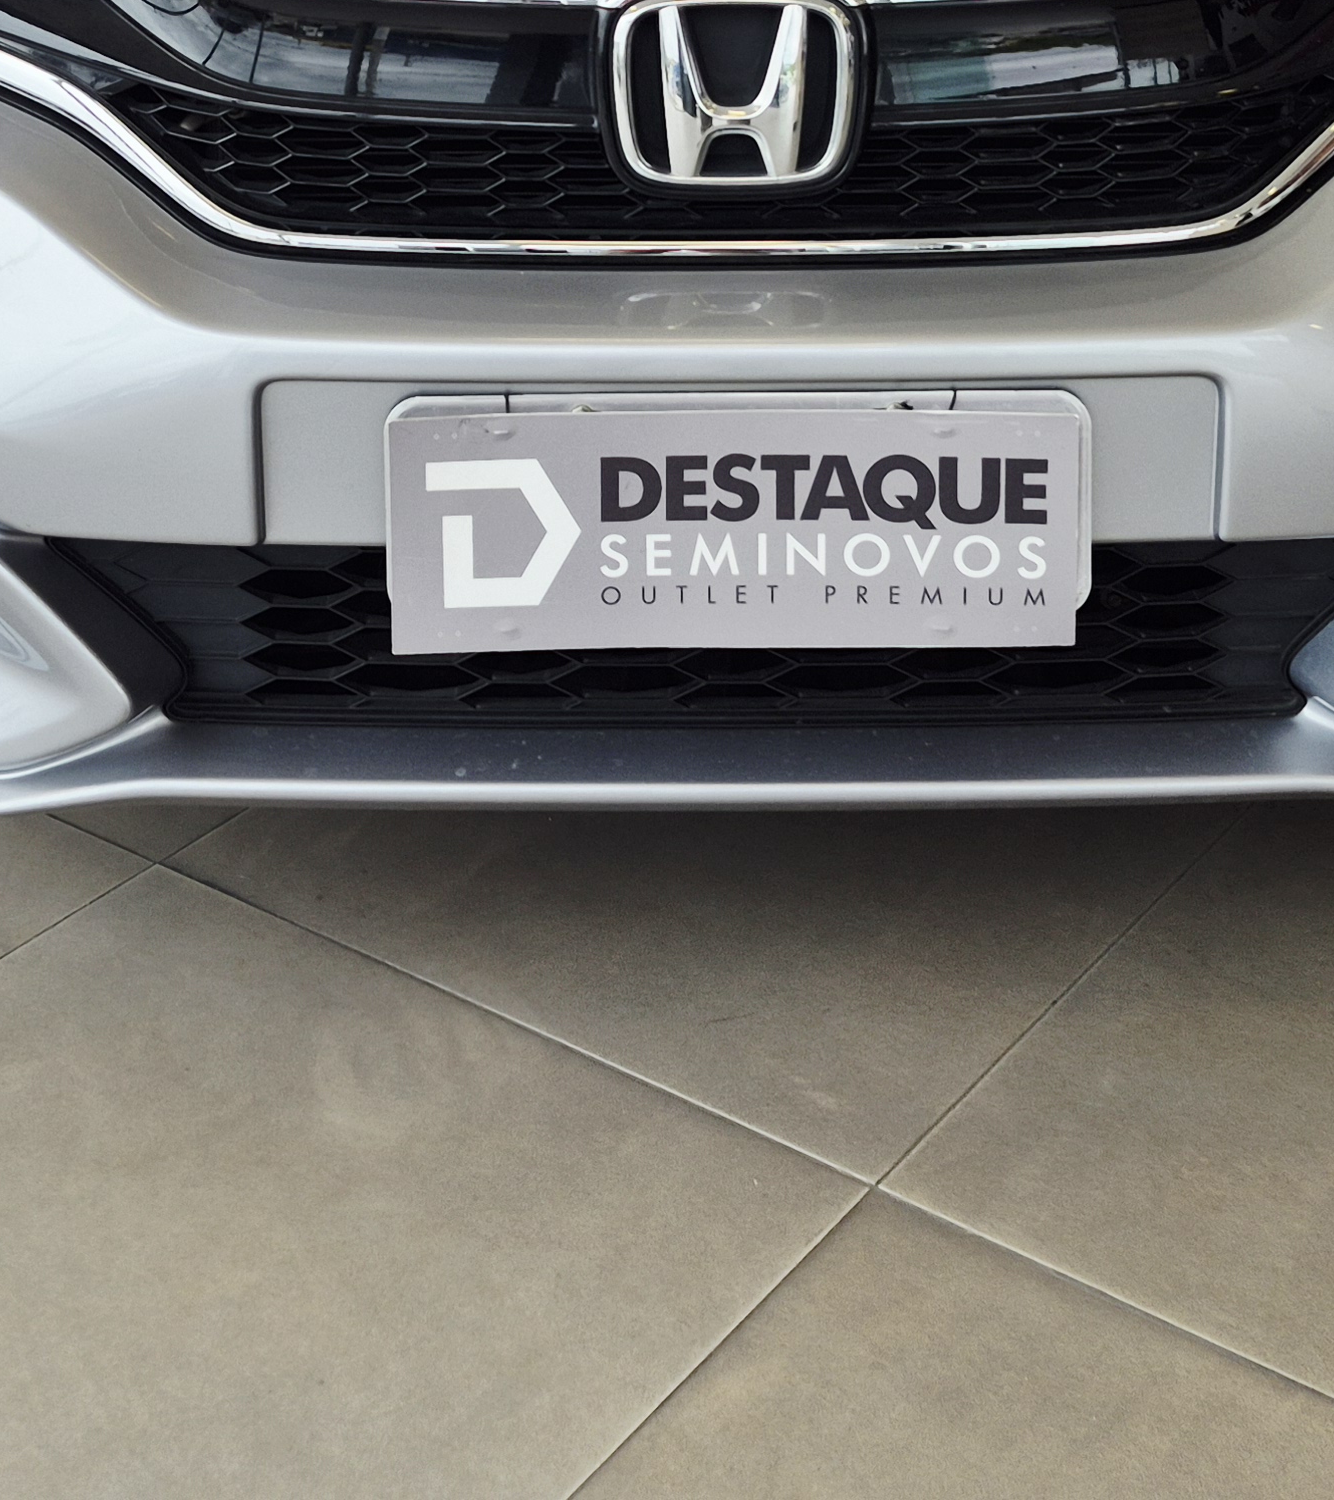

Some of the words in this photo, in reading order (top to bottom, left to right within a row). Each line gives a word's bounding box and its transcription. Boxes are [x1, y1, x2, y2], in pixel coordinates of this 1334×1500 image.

[600, 453, 1049, 530] DESTAQUE
[599, 532, 1048, 580] SEMINOVOS
[600, 585, 779, 605] OUTLET
[825, 585, 1046, 606] PREMIUM
